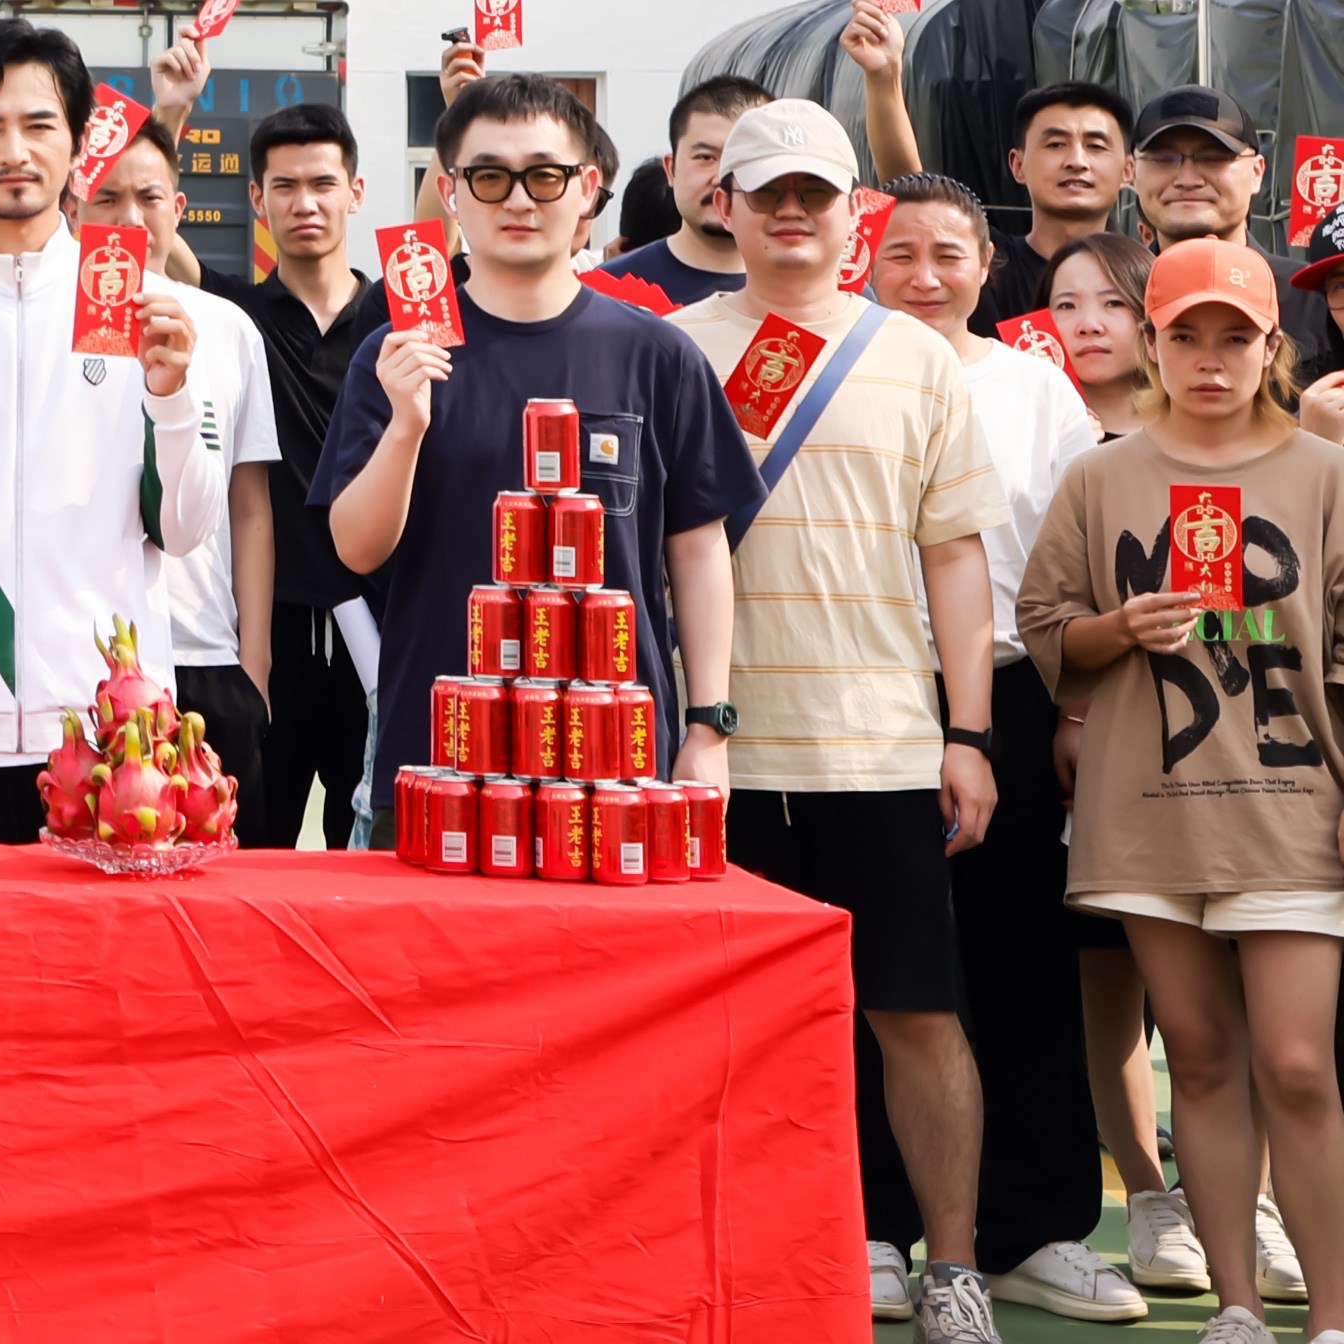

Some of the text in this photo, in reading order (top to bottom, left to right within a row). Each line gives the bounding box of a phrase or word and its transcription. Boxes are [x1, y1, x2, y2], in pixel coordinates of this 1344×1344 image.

[178, 153, 240, 173] 运通
[500, 512, 517, 573] 王老吉
[532, 607, 550, 669] 王老吉
[612, 610, 630, 673] 王老吉
[539, 706, 556, 769] 王老吉
[568, 707, 584, 770] 王老吉
[630, 706, 647, 769] 王老吉
[567, 805, 584, 868] 王老吉
